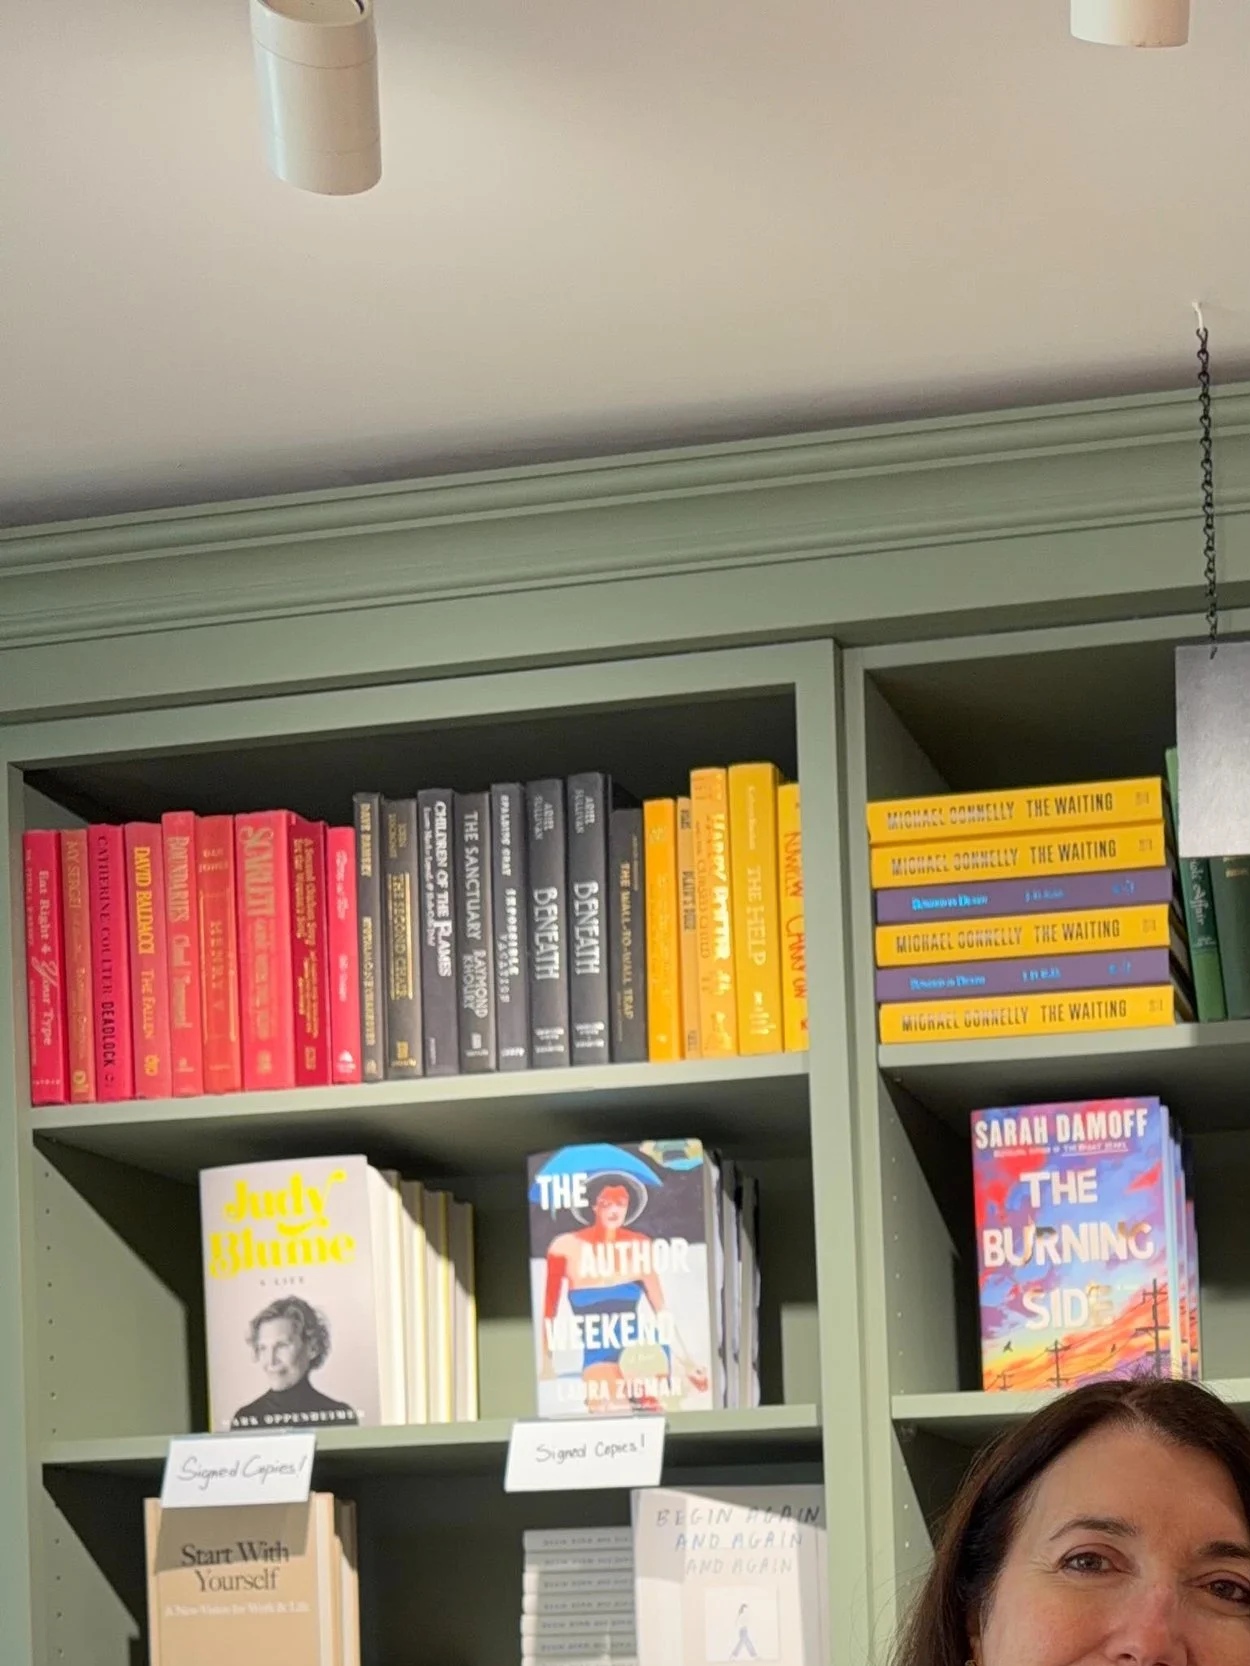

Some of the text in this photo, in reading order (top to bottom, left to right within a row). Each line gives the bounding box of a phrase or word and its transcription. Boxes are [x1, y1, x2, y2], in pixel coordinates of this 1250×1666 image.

[887, 792, 1113, 830] MICHAEL CONNELLY THE WAITING
[464, 812, 481, 941] THE SANCTUARY
[892, 839, 1117, 876] MICHAEL CONNELLY THE WAITING
[533, 887, 560, 980] BENEATH
[574, 880, 600, 975] BENEATH
[896, 919, 1120, 953] MICHAEL CONNELLY THE WAITING
[902, 998, 1127, 1032] MICHAEL CONNELLY THE WAITING
[974, 1118, 1048, 1150] SARAH
[1056, 1108, 1148, 1143] DAMOFF
[222, 1170, 348, 1237] Judy
[536, 1172, 590, 1213] THE
[1020, 1168, 1098, 1208] THE
[207, 1226, 357, 1279] Blume
[578, 1238, 691, 1279] AUTHOR
[983, 1221, 1154, 1268] BURNING
[1021, 1283, 1113, 1329] SIDE
[545, 1311, 674, 1352] WEEKEND
[178, 1455, 308, 1491] Signed Copies!
[536, 1444, 586, 1464] Signed
[181, 1540, 289, 1567] Start With
[195, 1567, 279, 1592] Yourself
